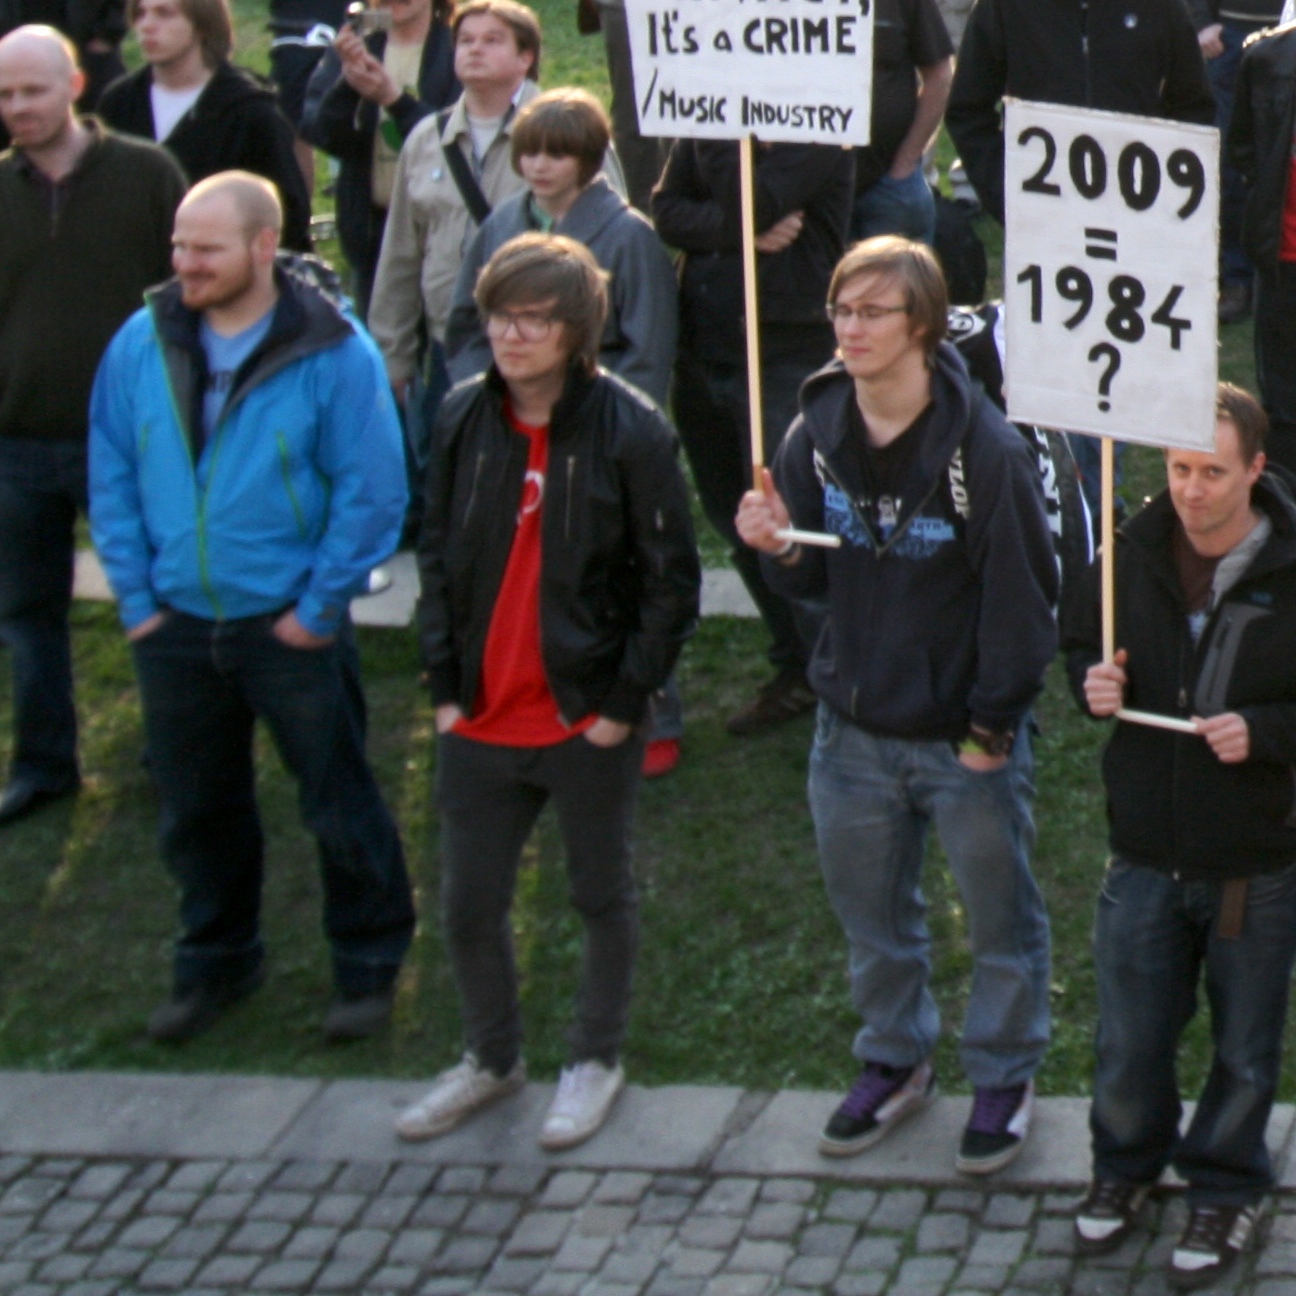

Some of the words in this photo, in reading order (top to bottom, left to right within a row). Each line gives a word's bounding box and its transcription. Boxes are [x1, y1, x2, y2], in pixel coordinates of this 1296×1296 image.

[648, 10, 699, 57] It's
[713, 30, 733, 52] a
[743, 15, 857, 54] CRIME
[1017, 126, 1206, 221] 2009
[1017, 264, 1192, 351] 1984
